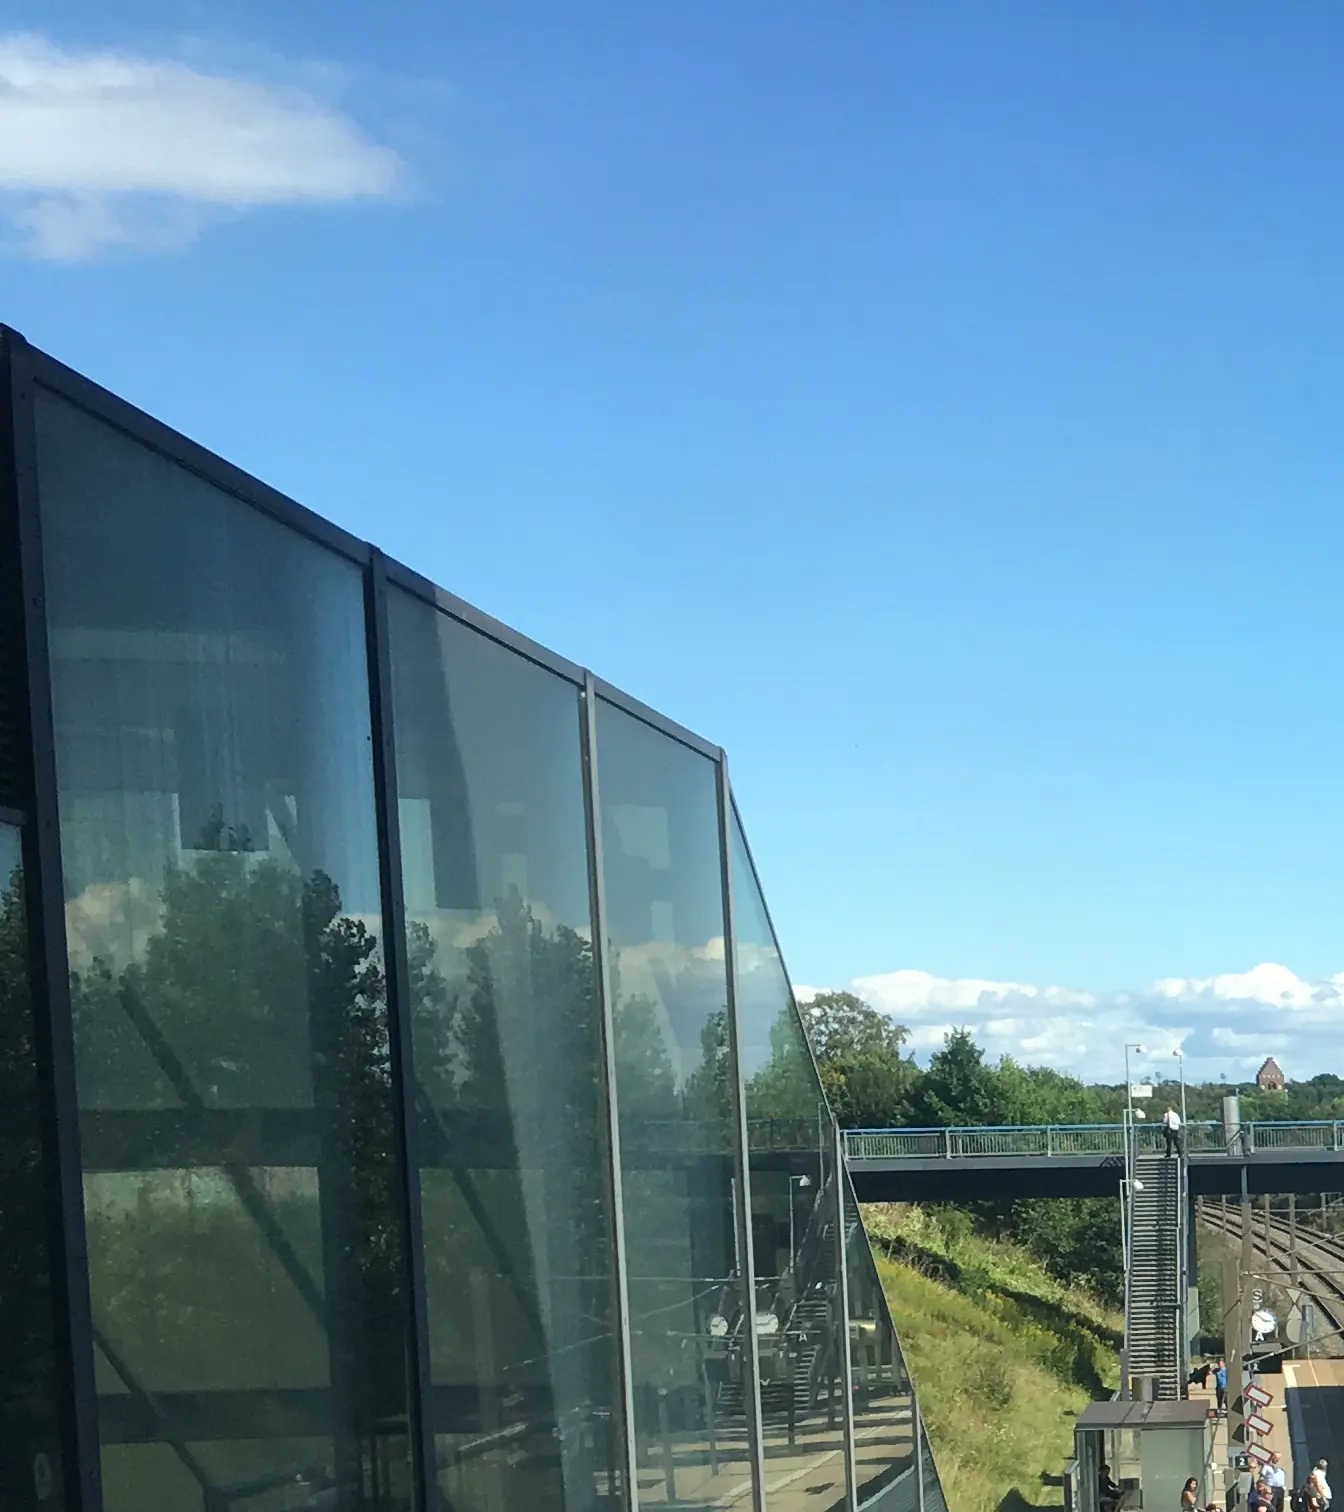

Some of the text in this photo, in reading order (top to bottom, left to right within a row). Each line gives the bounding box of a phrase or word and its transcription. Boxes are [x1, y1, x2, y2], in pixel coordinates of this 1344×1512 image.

[1252, 1289, 1263, 1302] S
[1255, 1332, 1265, 1341] A
[1239, 1458, 1246, 1466] 2
